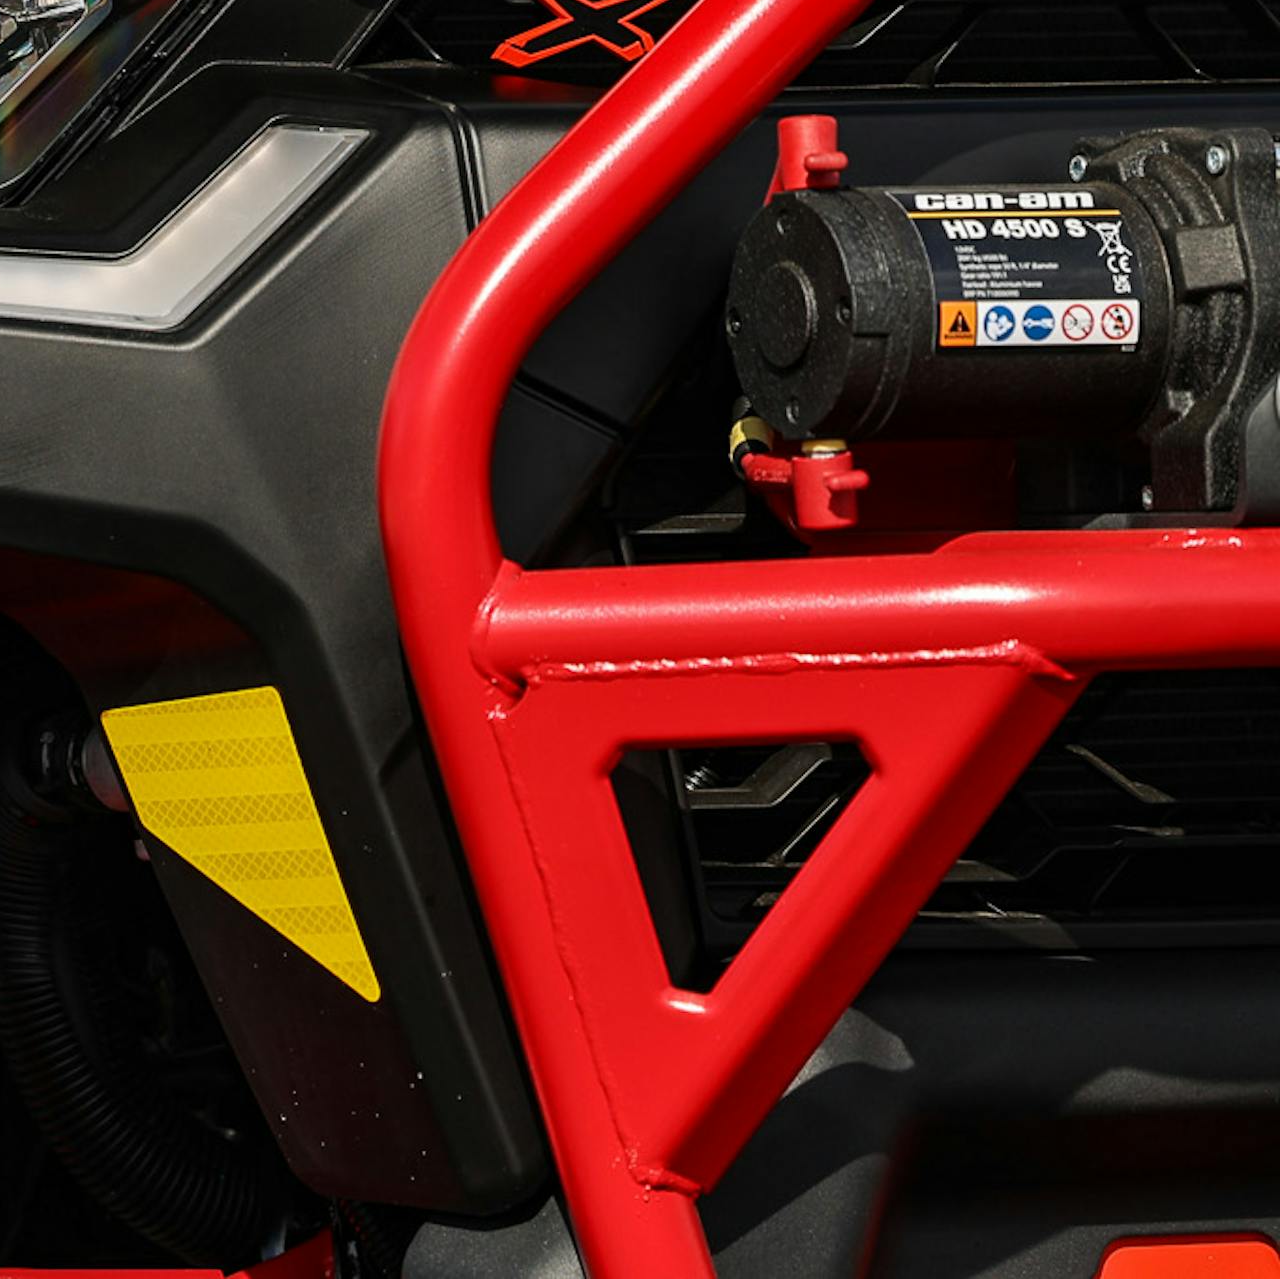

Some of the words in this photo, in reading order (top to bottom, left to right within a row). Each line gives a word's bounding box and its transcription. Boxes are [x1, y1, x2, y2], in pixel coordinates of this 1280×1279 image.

[914, 191, 1094, 210] can-am
[942, 219, 987, 240] HD
[991, 219, 1060, 239] 4500
[1064, 218, 1087, 238] S
